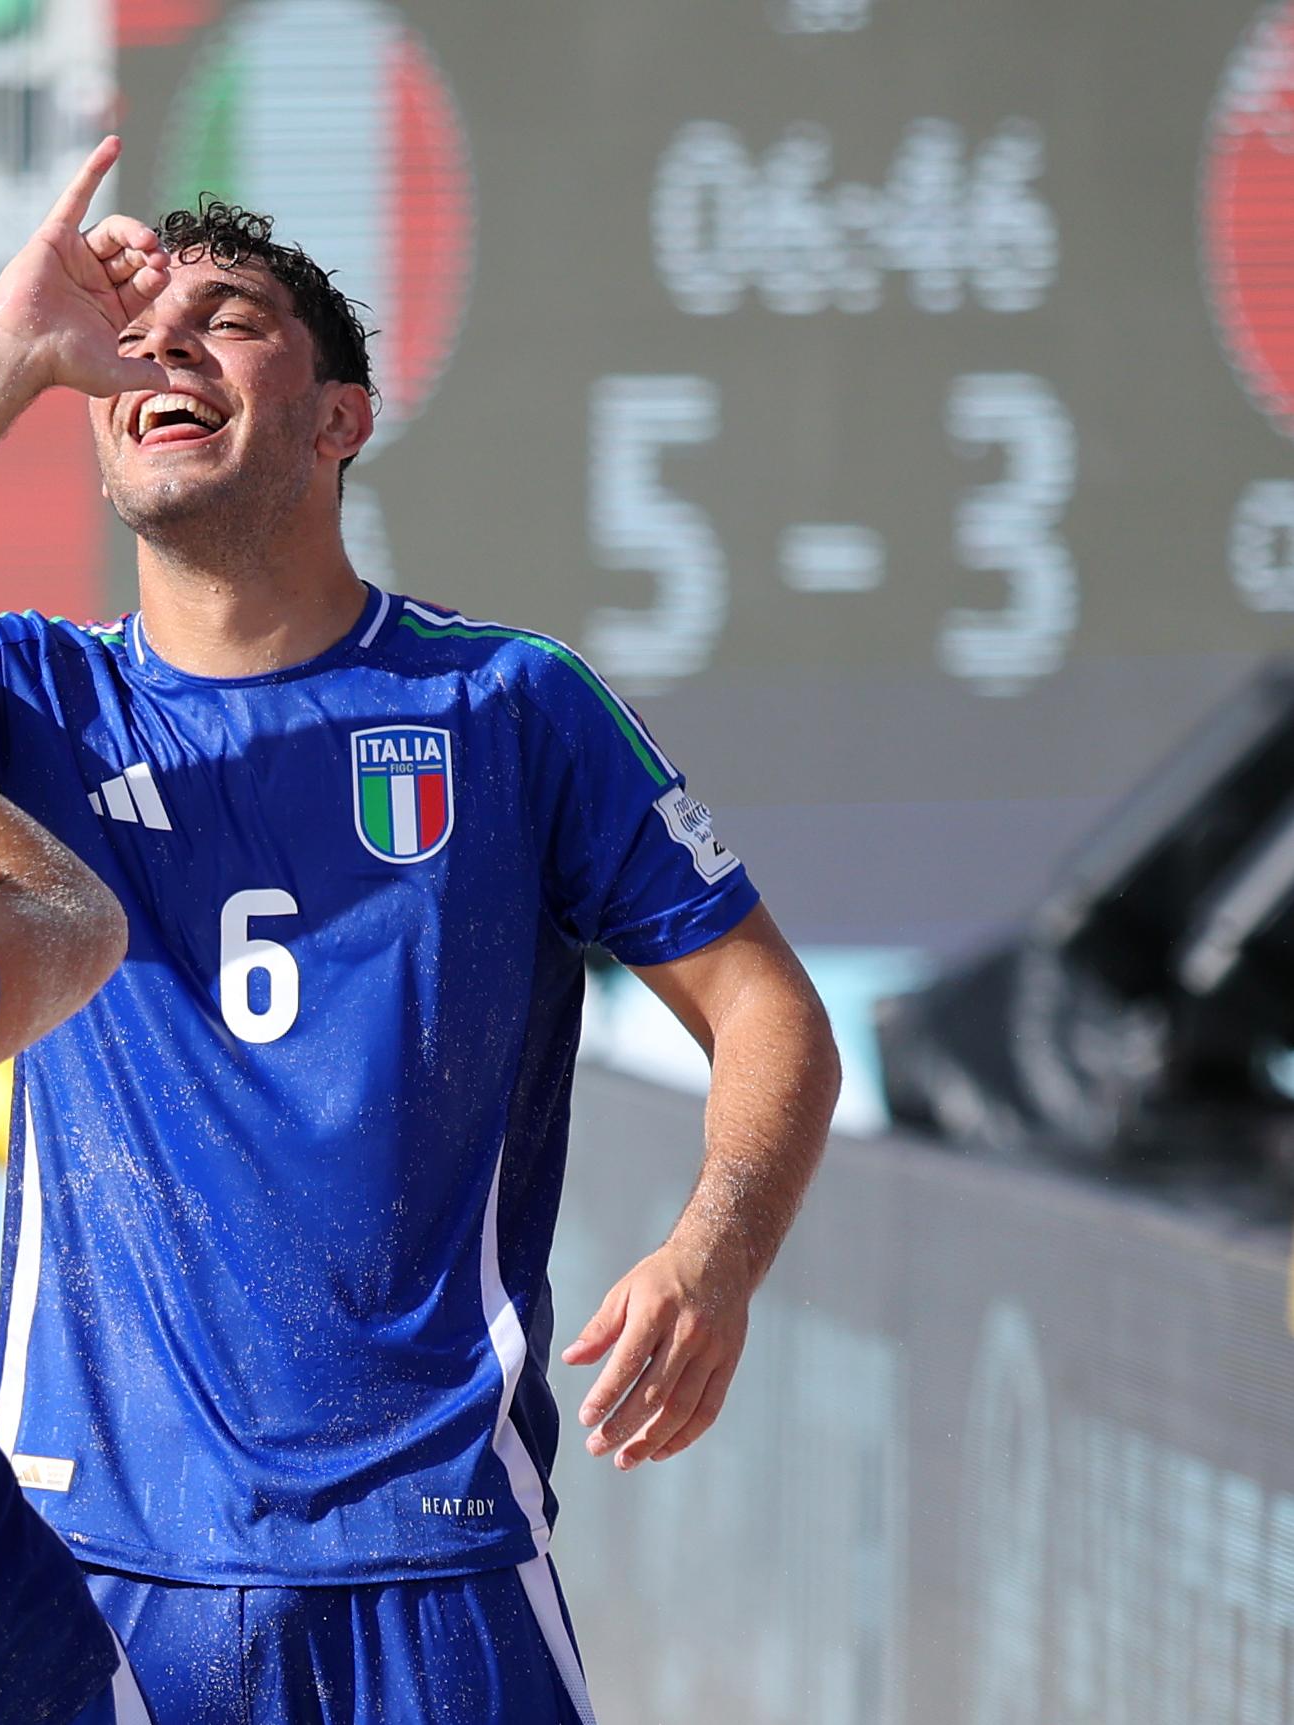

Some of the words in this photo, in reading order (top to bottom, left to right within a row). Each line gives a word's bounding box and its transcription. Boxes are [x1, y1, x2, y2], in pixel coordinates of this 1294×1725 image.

[587, 373, 727, 690] 5
[938, 372, 1079, 690] 3
[359, 737, 443, 763] ITALIA
[390, 763, 414, 773] FIGC
[220, 888, 299, 1044] 6
